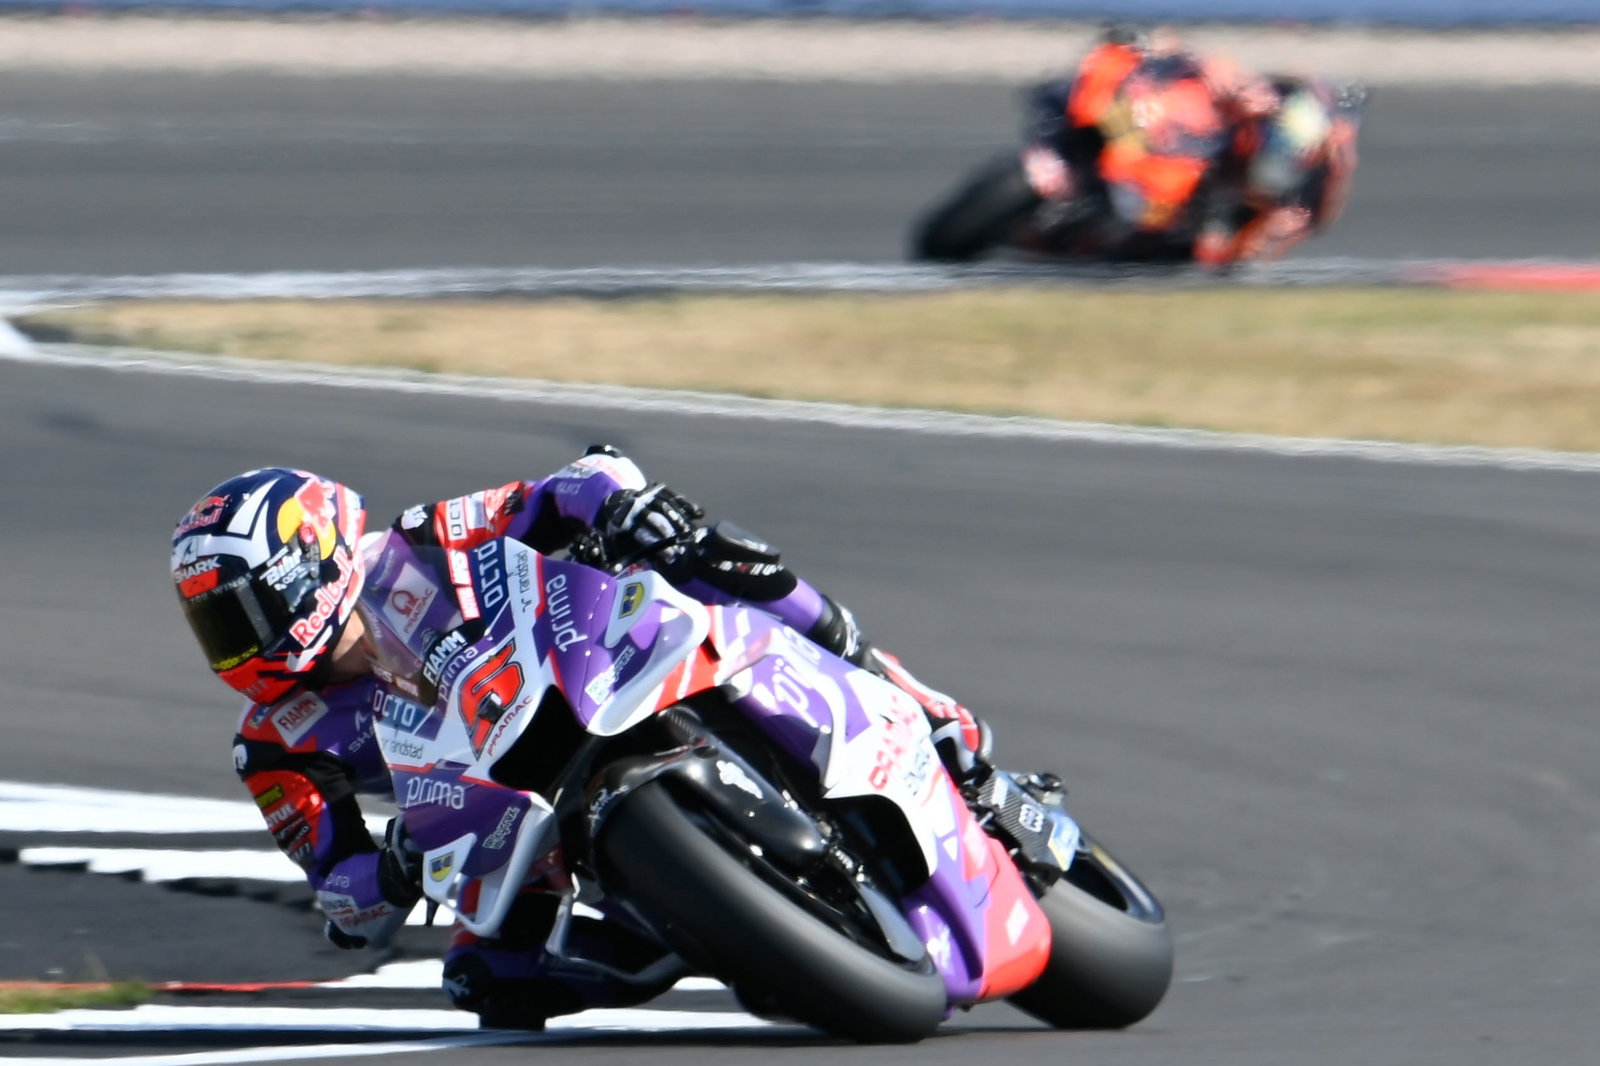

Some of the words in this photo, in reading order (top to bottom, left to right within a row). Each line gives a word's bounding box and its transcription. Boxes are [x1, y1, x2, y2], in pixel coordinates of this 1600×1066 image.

[174, 555, 221, 583] SHARK
[478, 539, 504, 609] OCTO
[513, 549, 530, 594] randstad
[404, 588, 435, 635] PRAMAC
[546, 573, 588, 653] prima
[423, 630, 468, 686] FIAMM
[438, 646, 479, 705] prima
[372, 689, 416, 727] OCTO
[487, 695, 533, 757] PRAMAC
[405, 776, 465, 810] prima
